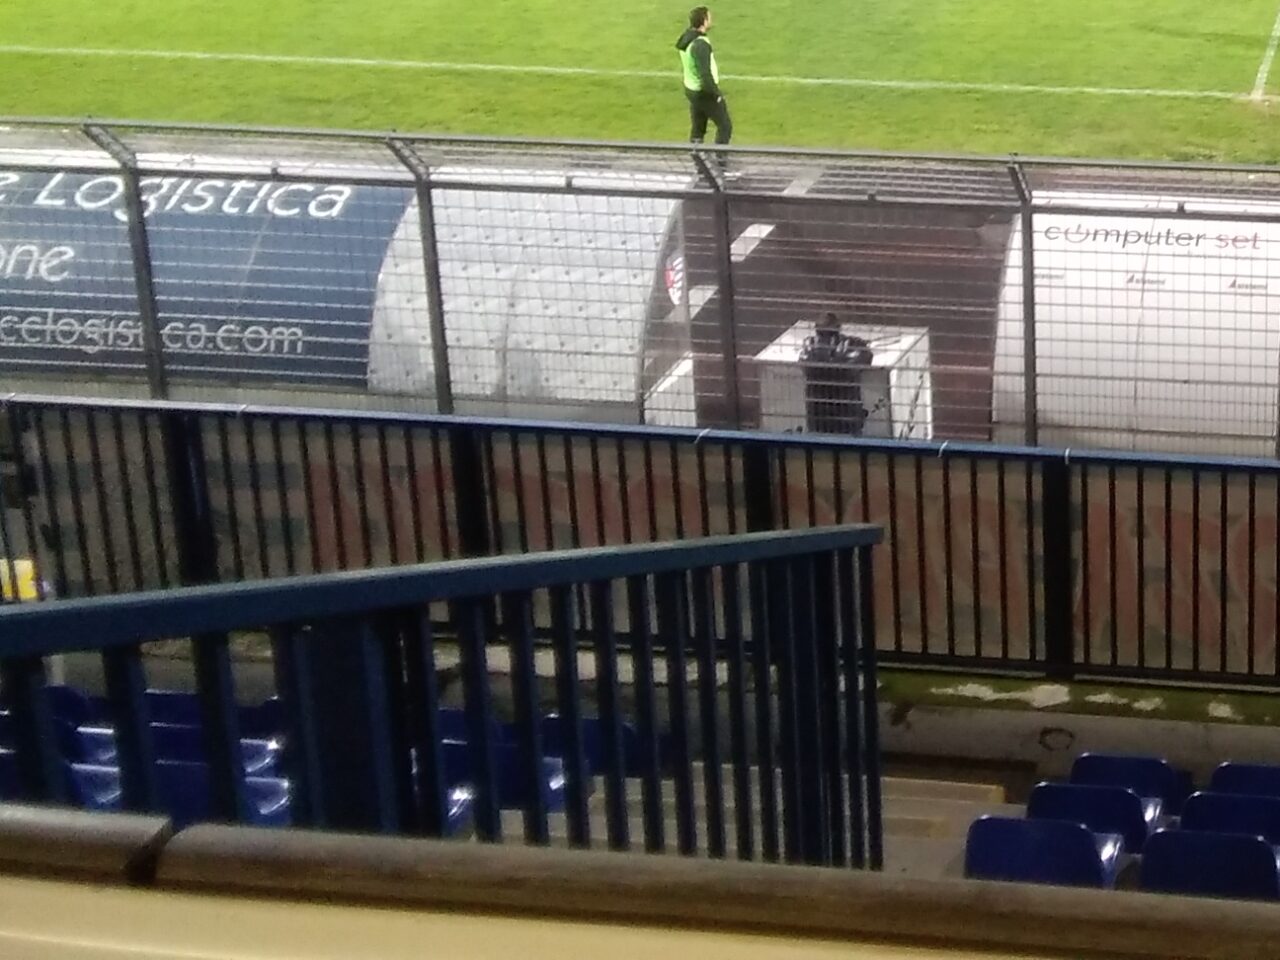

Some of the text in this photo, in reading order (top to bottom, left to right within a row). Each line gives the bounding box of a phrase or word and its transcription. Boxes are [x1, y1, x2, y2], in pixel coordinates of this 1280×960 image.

[34, 172, 352, 222] Logistica
[1044, 223, 1261, 250] computer set
[0, 307, 304, 354] cclogisca.com
